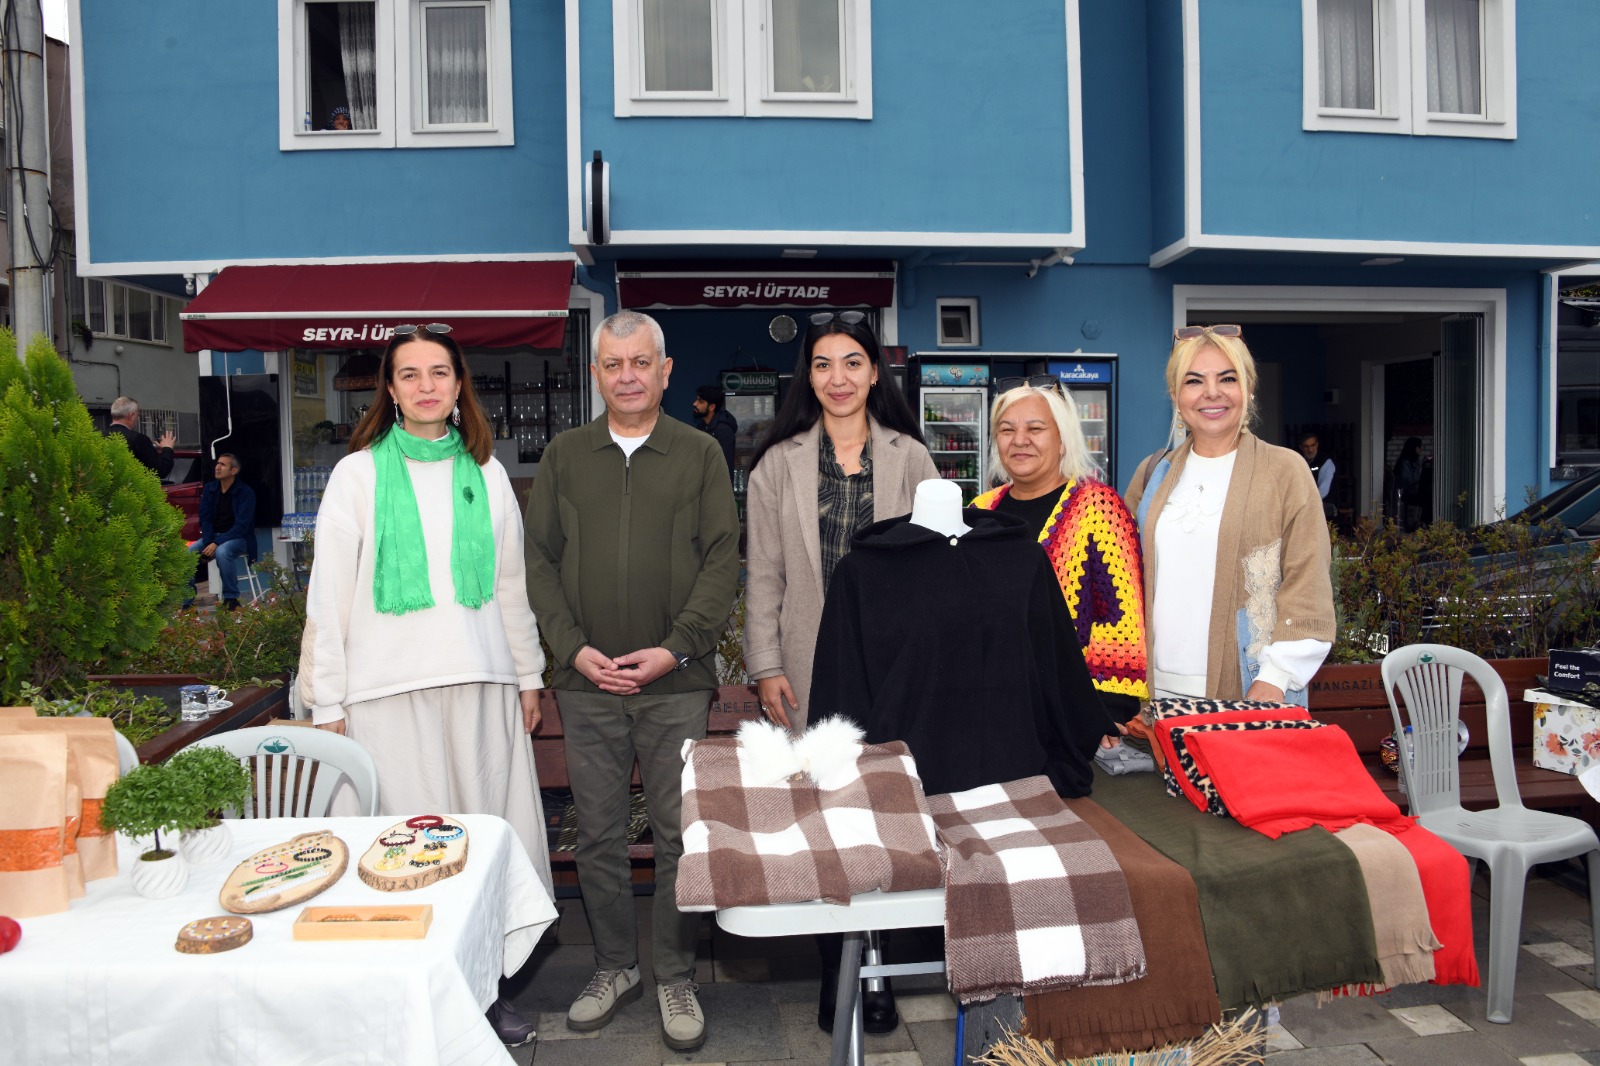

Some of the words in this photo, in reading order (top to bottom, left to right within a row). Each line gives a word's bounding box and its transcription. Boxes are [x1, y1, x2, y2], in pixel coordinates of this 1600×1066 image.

[703, 283, 762, 298] SEYR-İ
[763, 283, 830, 298] ÜFTADE
[302, 324, 368, 341] SEYR-İ
[370, 324, 395, 341] ÜF
[1060, 371, 1099, 380] karacakaya
[1553, 671, 1581, 679] Comfort
[1309, 677, 1373, 692] MANGAZİ
